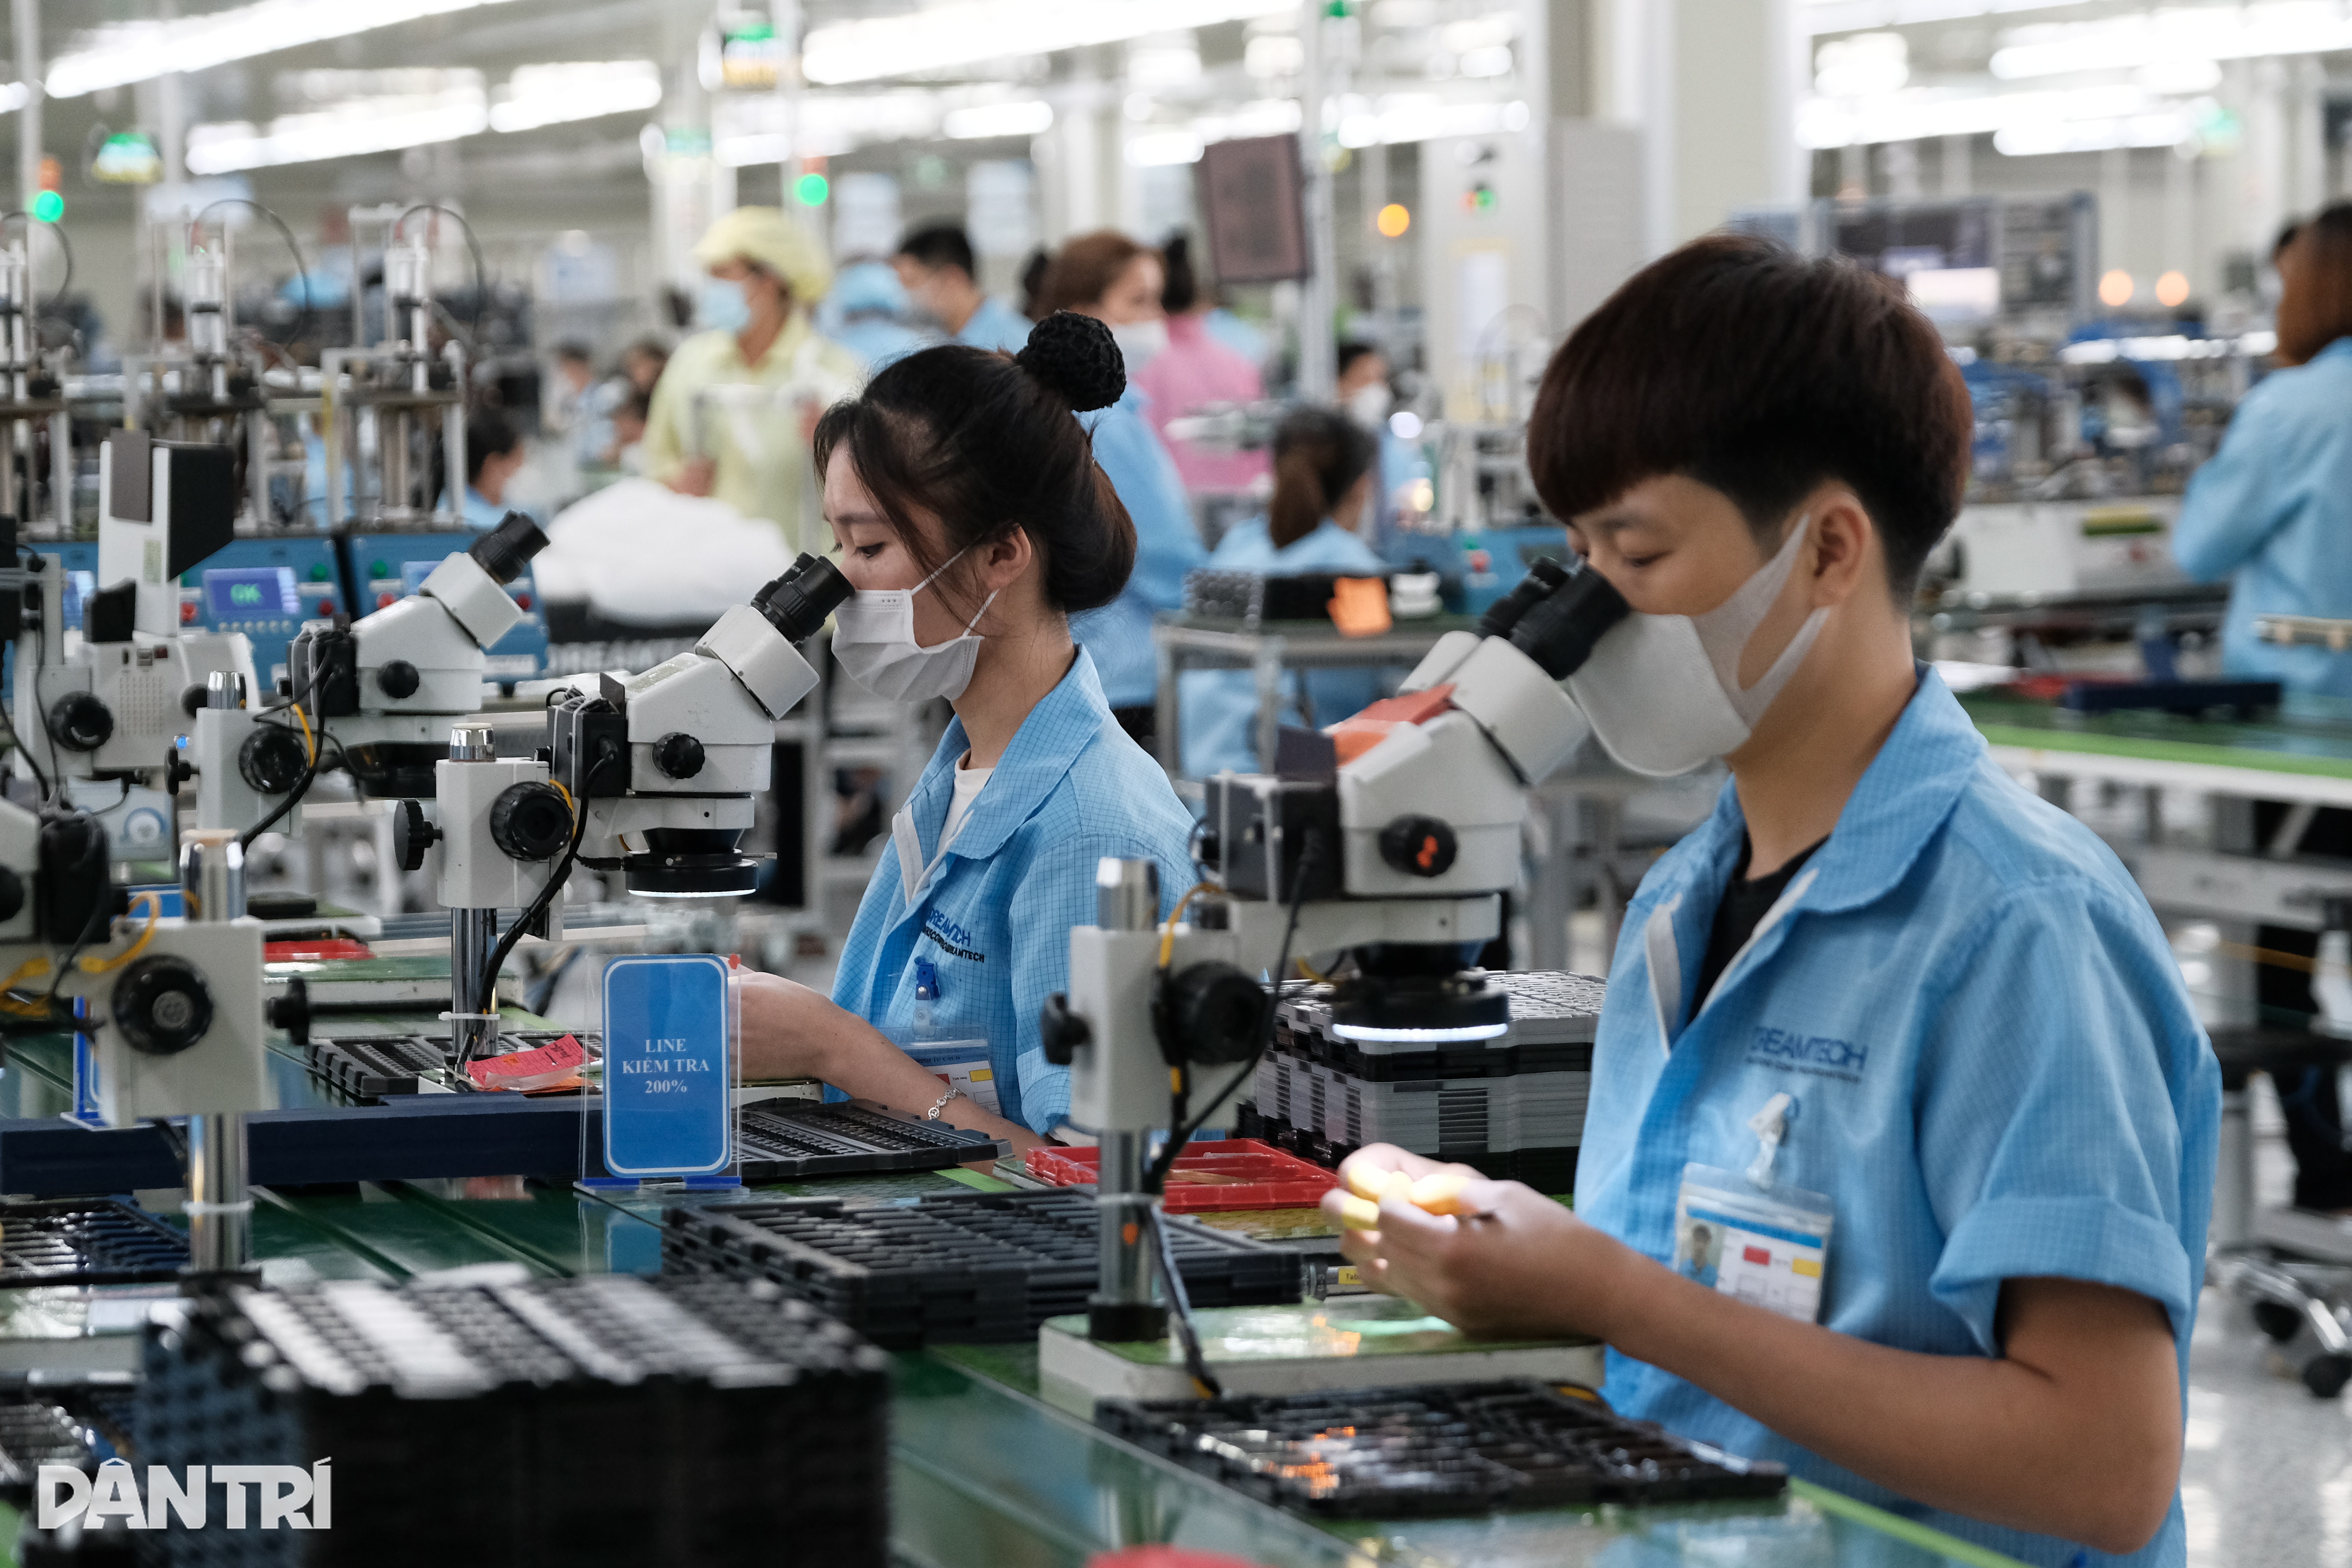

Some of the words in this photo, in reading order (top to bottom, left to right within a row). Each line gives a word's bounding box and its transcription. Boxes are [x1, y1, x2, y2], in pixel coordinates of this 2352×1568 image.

[645, 1038, 686, 1053] LINE
[622, 1056, 668, 1074] KIỂM
[674, 1059, 709, 1072] TRA
[645, 1079, 687, 1093] 200%
